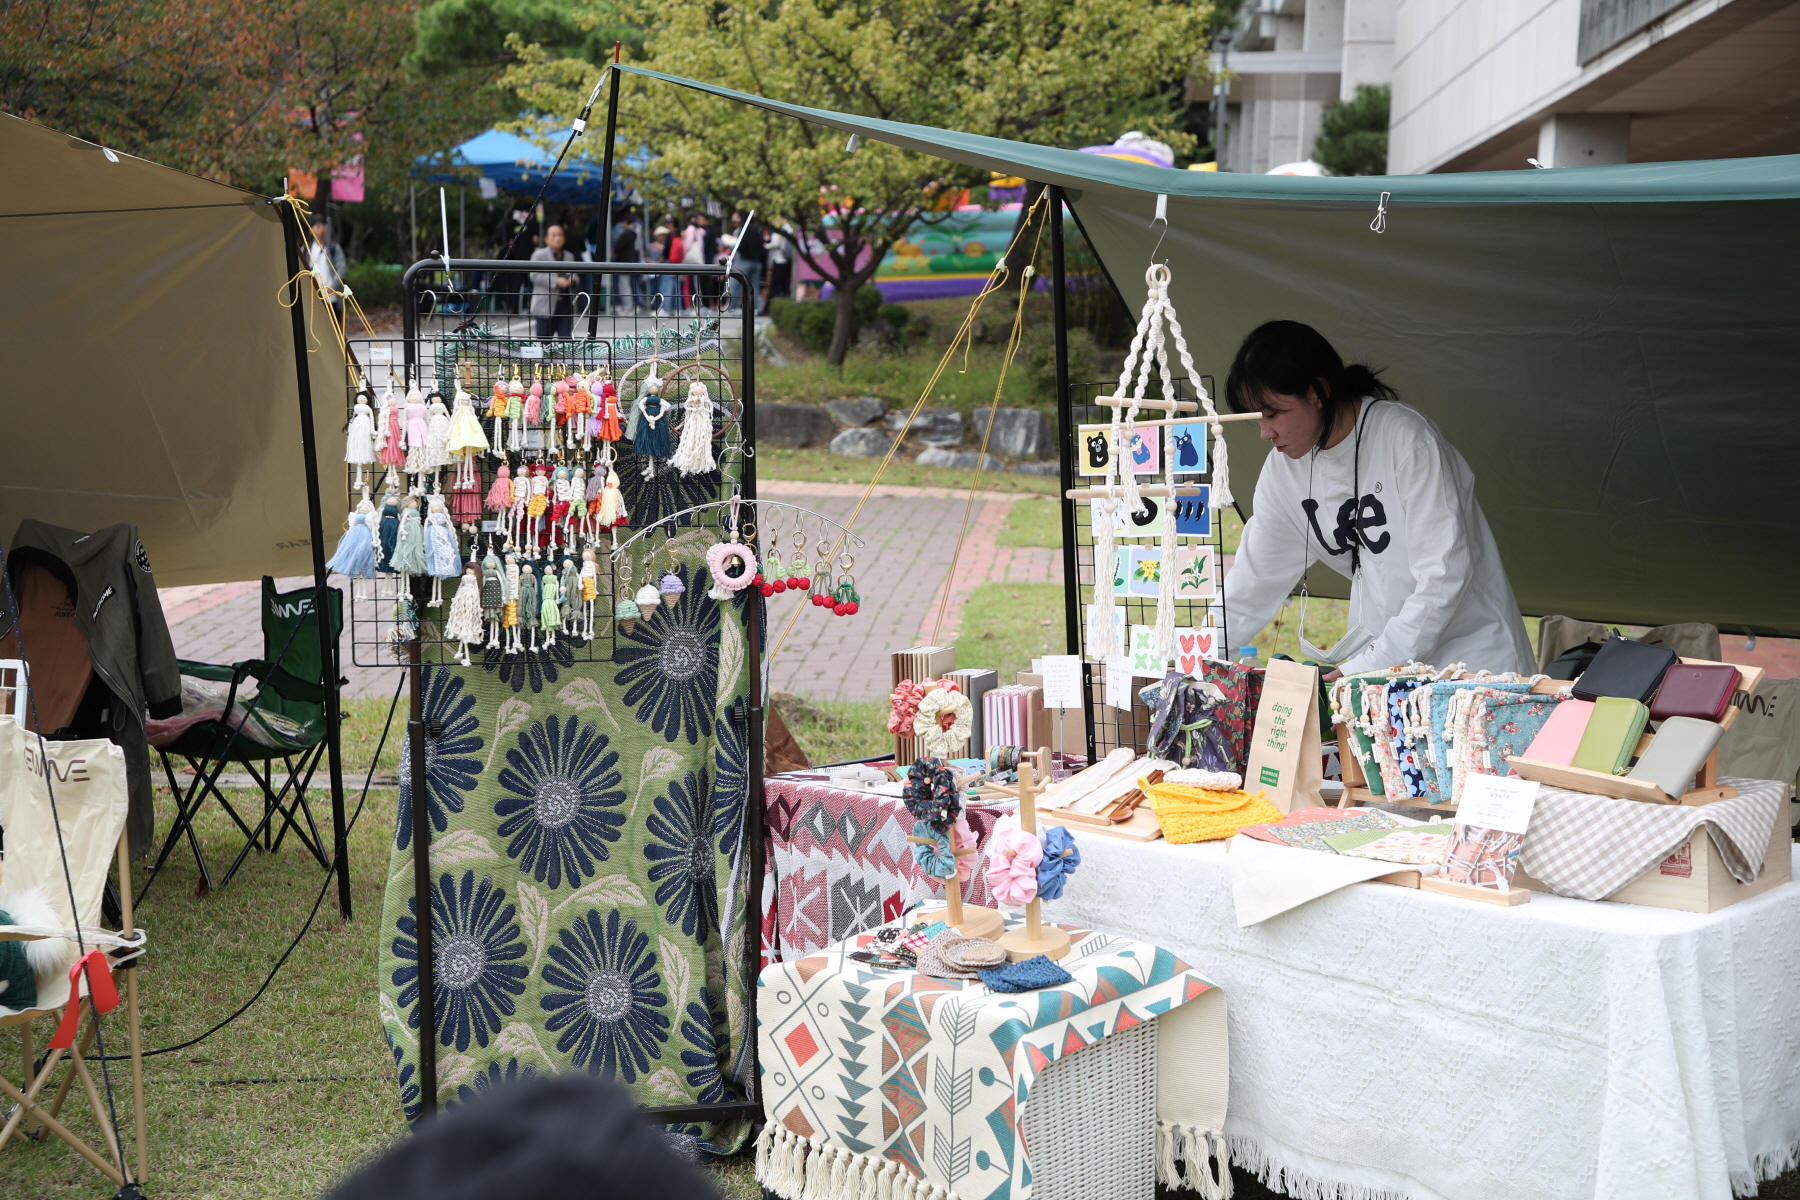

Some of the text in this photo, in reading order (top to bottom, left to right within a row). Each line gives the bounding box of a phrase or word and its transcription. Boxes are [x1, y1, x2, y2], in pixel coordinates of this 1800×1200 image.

[1301, 494, 1390, 556] Lee
[1271, 702, 1293, 717] doing
[1274, 715, 1286, 726] the
[1270, 726, 1287, 738] right
[1267, 738, 1288, 752] thing!
